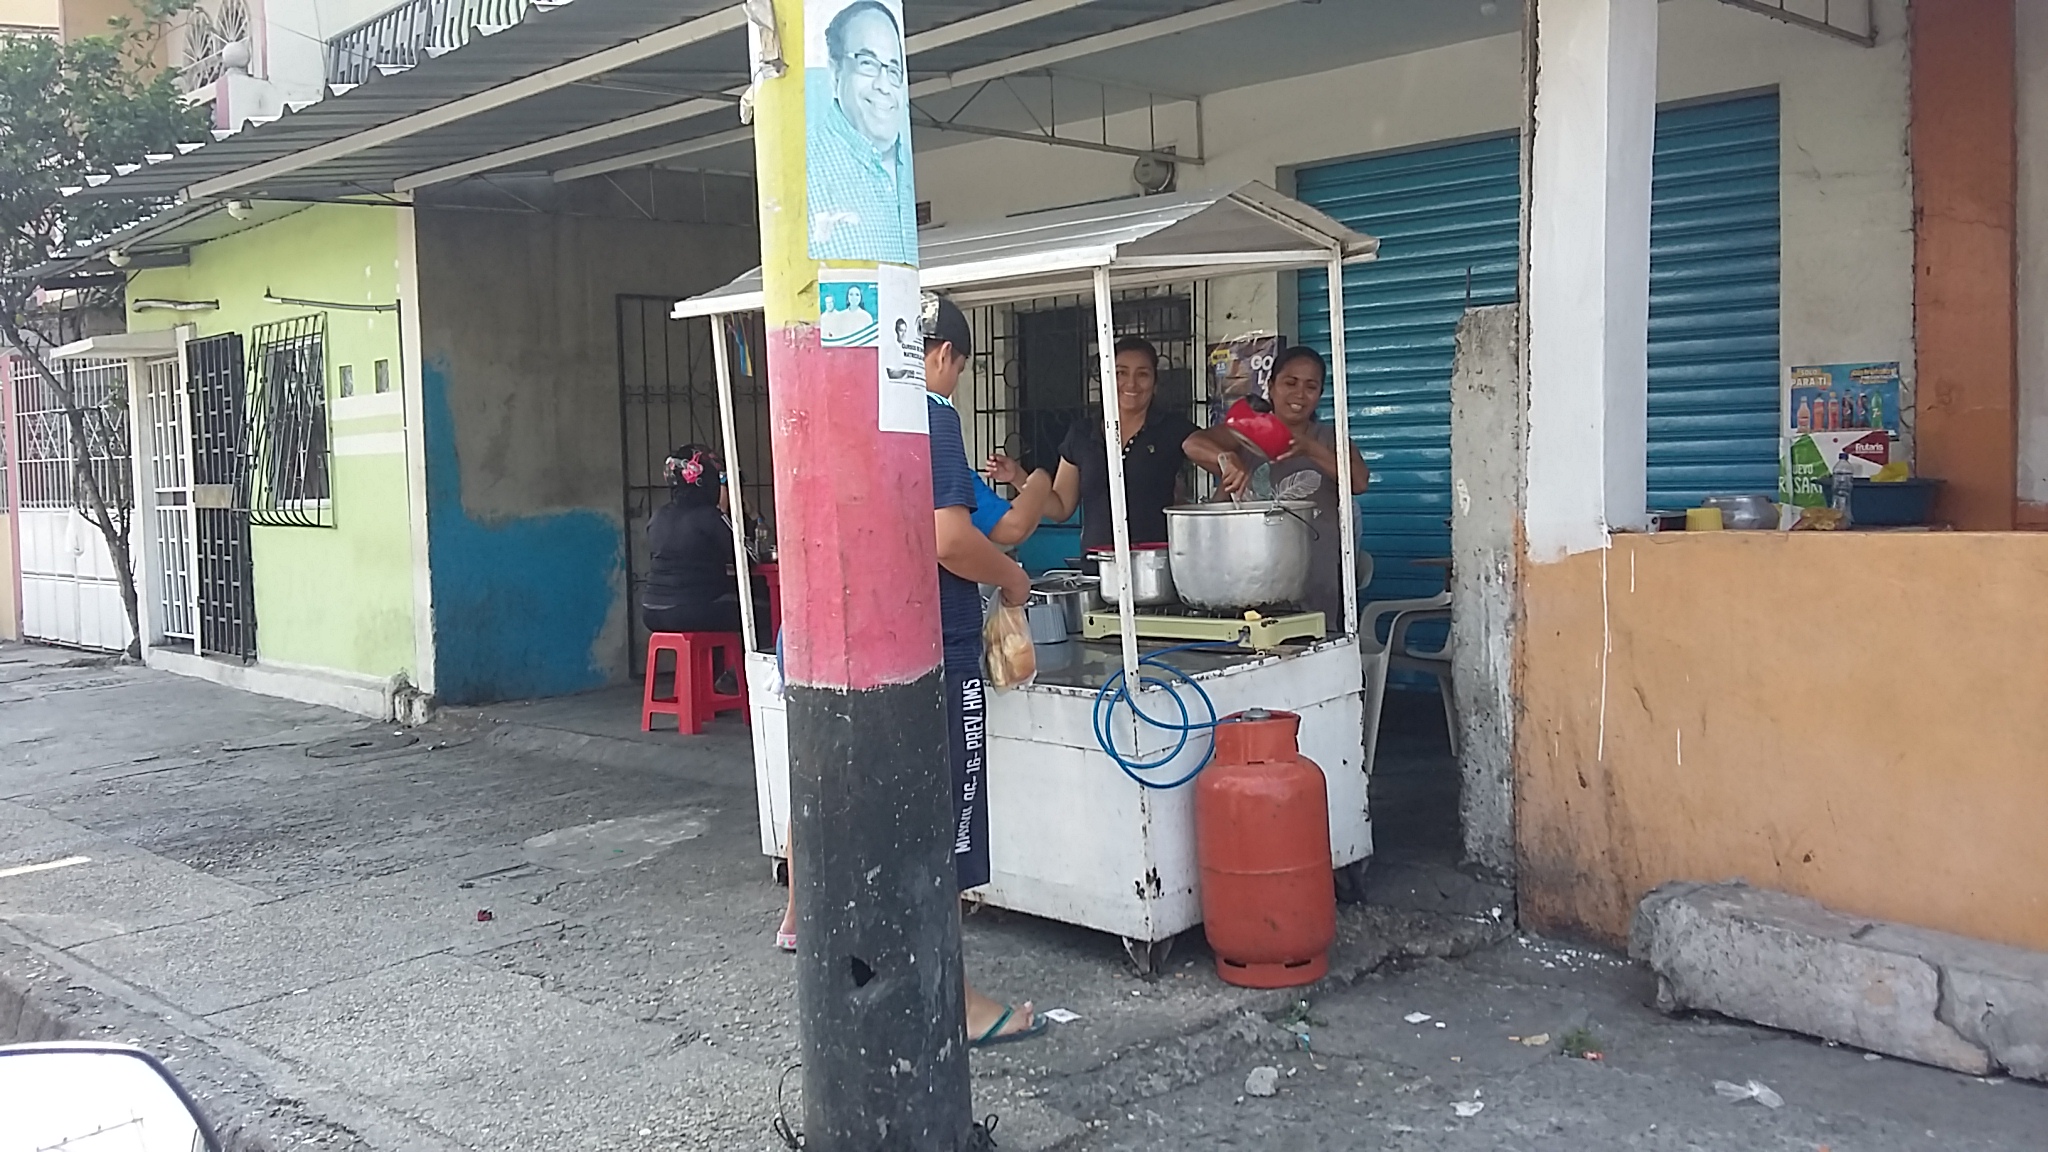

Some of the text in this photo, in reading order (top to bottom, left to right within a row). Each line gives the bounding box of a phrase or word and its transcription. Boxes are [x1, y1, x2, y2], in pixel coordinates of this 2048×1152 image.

[1250, 355, 1273, 370] GO
[1792, 464, 1814, 475] UEVO
[961, 678, 983, 711] HMS
